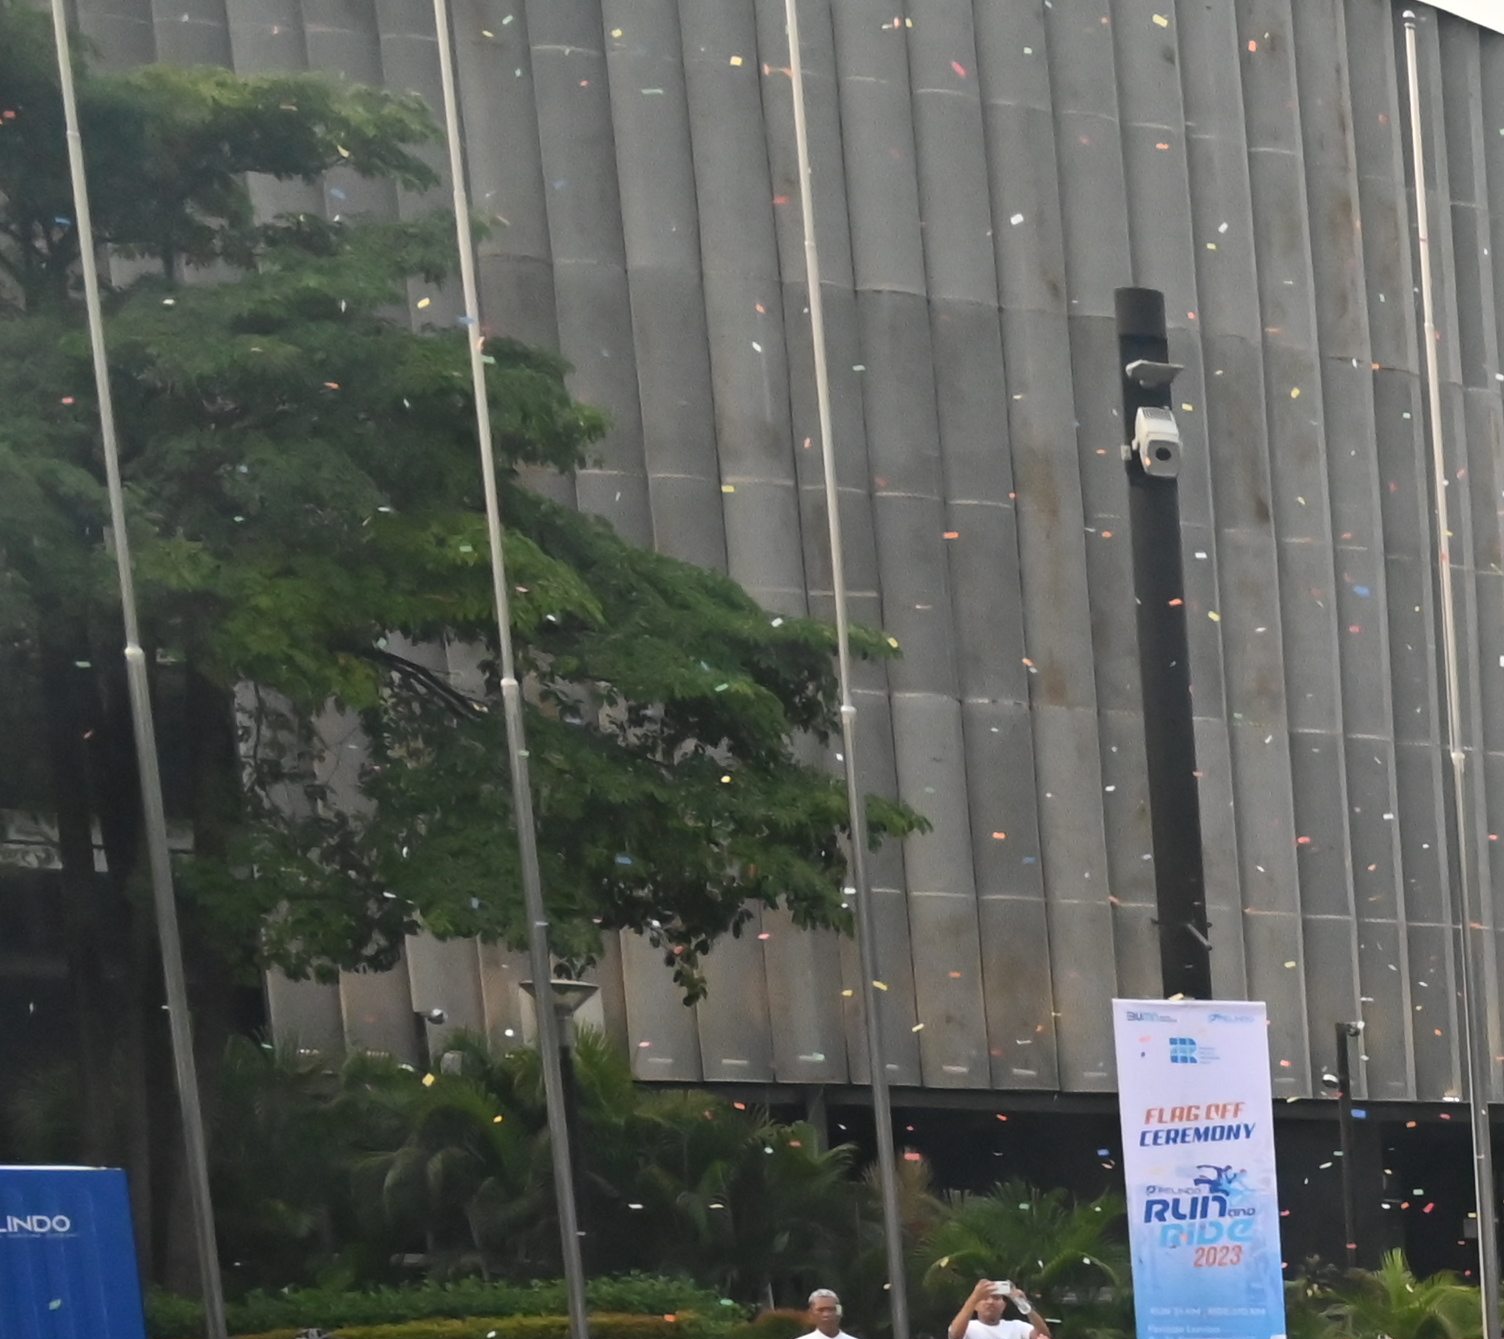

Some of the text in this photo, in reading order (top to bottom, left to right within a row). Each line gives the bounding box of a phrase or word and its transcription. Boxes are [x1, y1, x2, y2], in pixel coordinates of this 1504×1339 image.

[1145, 1102, 1245, 1124] FLAG OFF
[1139, 1122, 1256, 1147] CEREMONY
[1194, 1244, 1243, 1267] 2023
